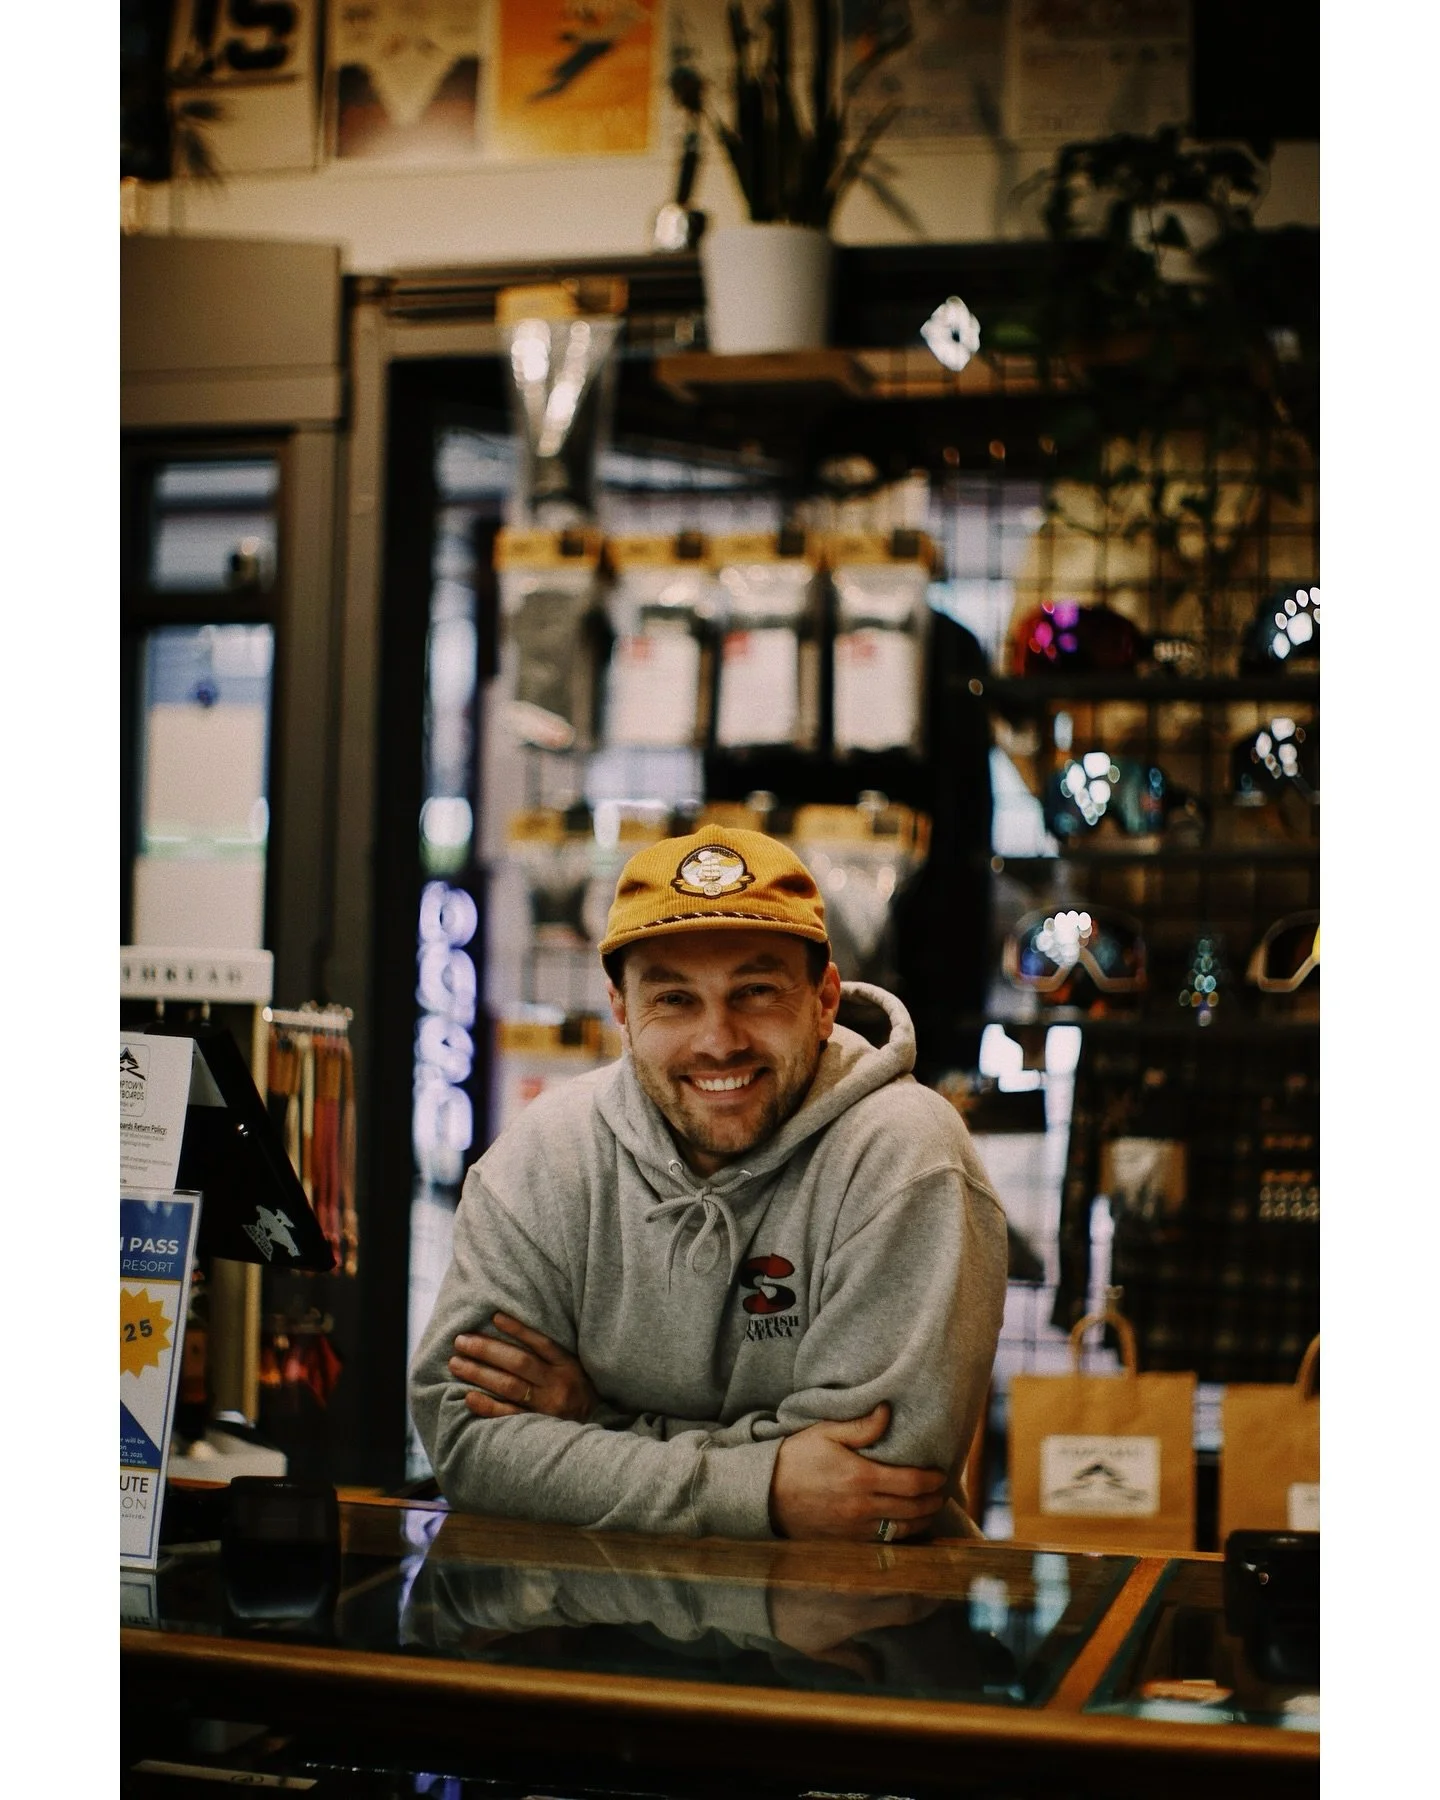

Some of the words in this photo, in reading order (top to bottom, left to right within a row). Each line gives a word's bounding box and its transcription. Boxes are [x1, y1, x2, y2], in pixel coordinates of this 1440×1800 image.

[120, 1090, 145, 1101] BOARDS
[129, 1237, 180, 1255] PASS
[122, 1259, 175, 1273] RESORT
[120, 1475, 149, 1493] UTE
[122, 1497, 147, 1510] ON
